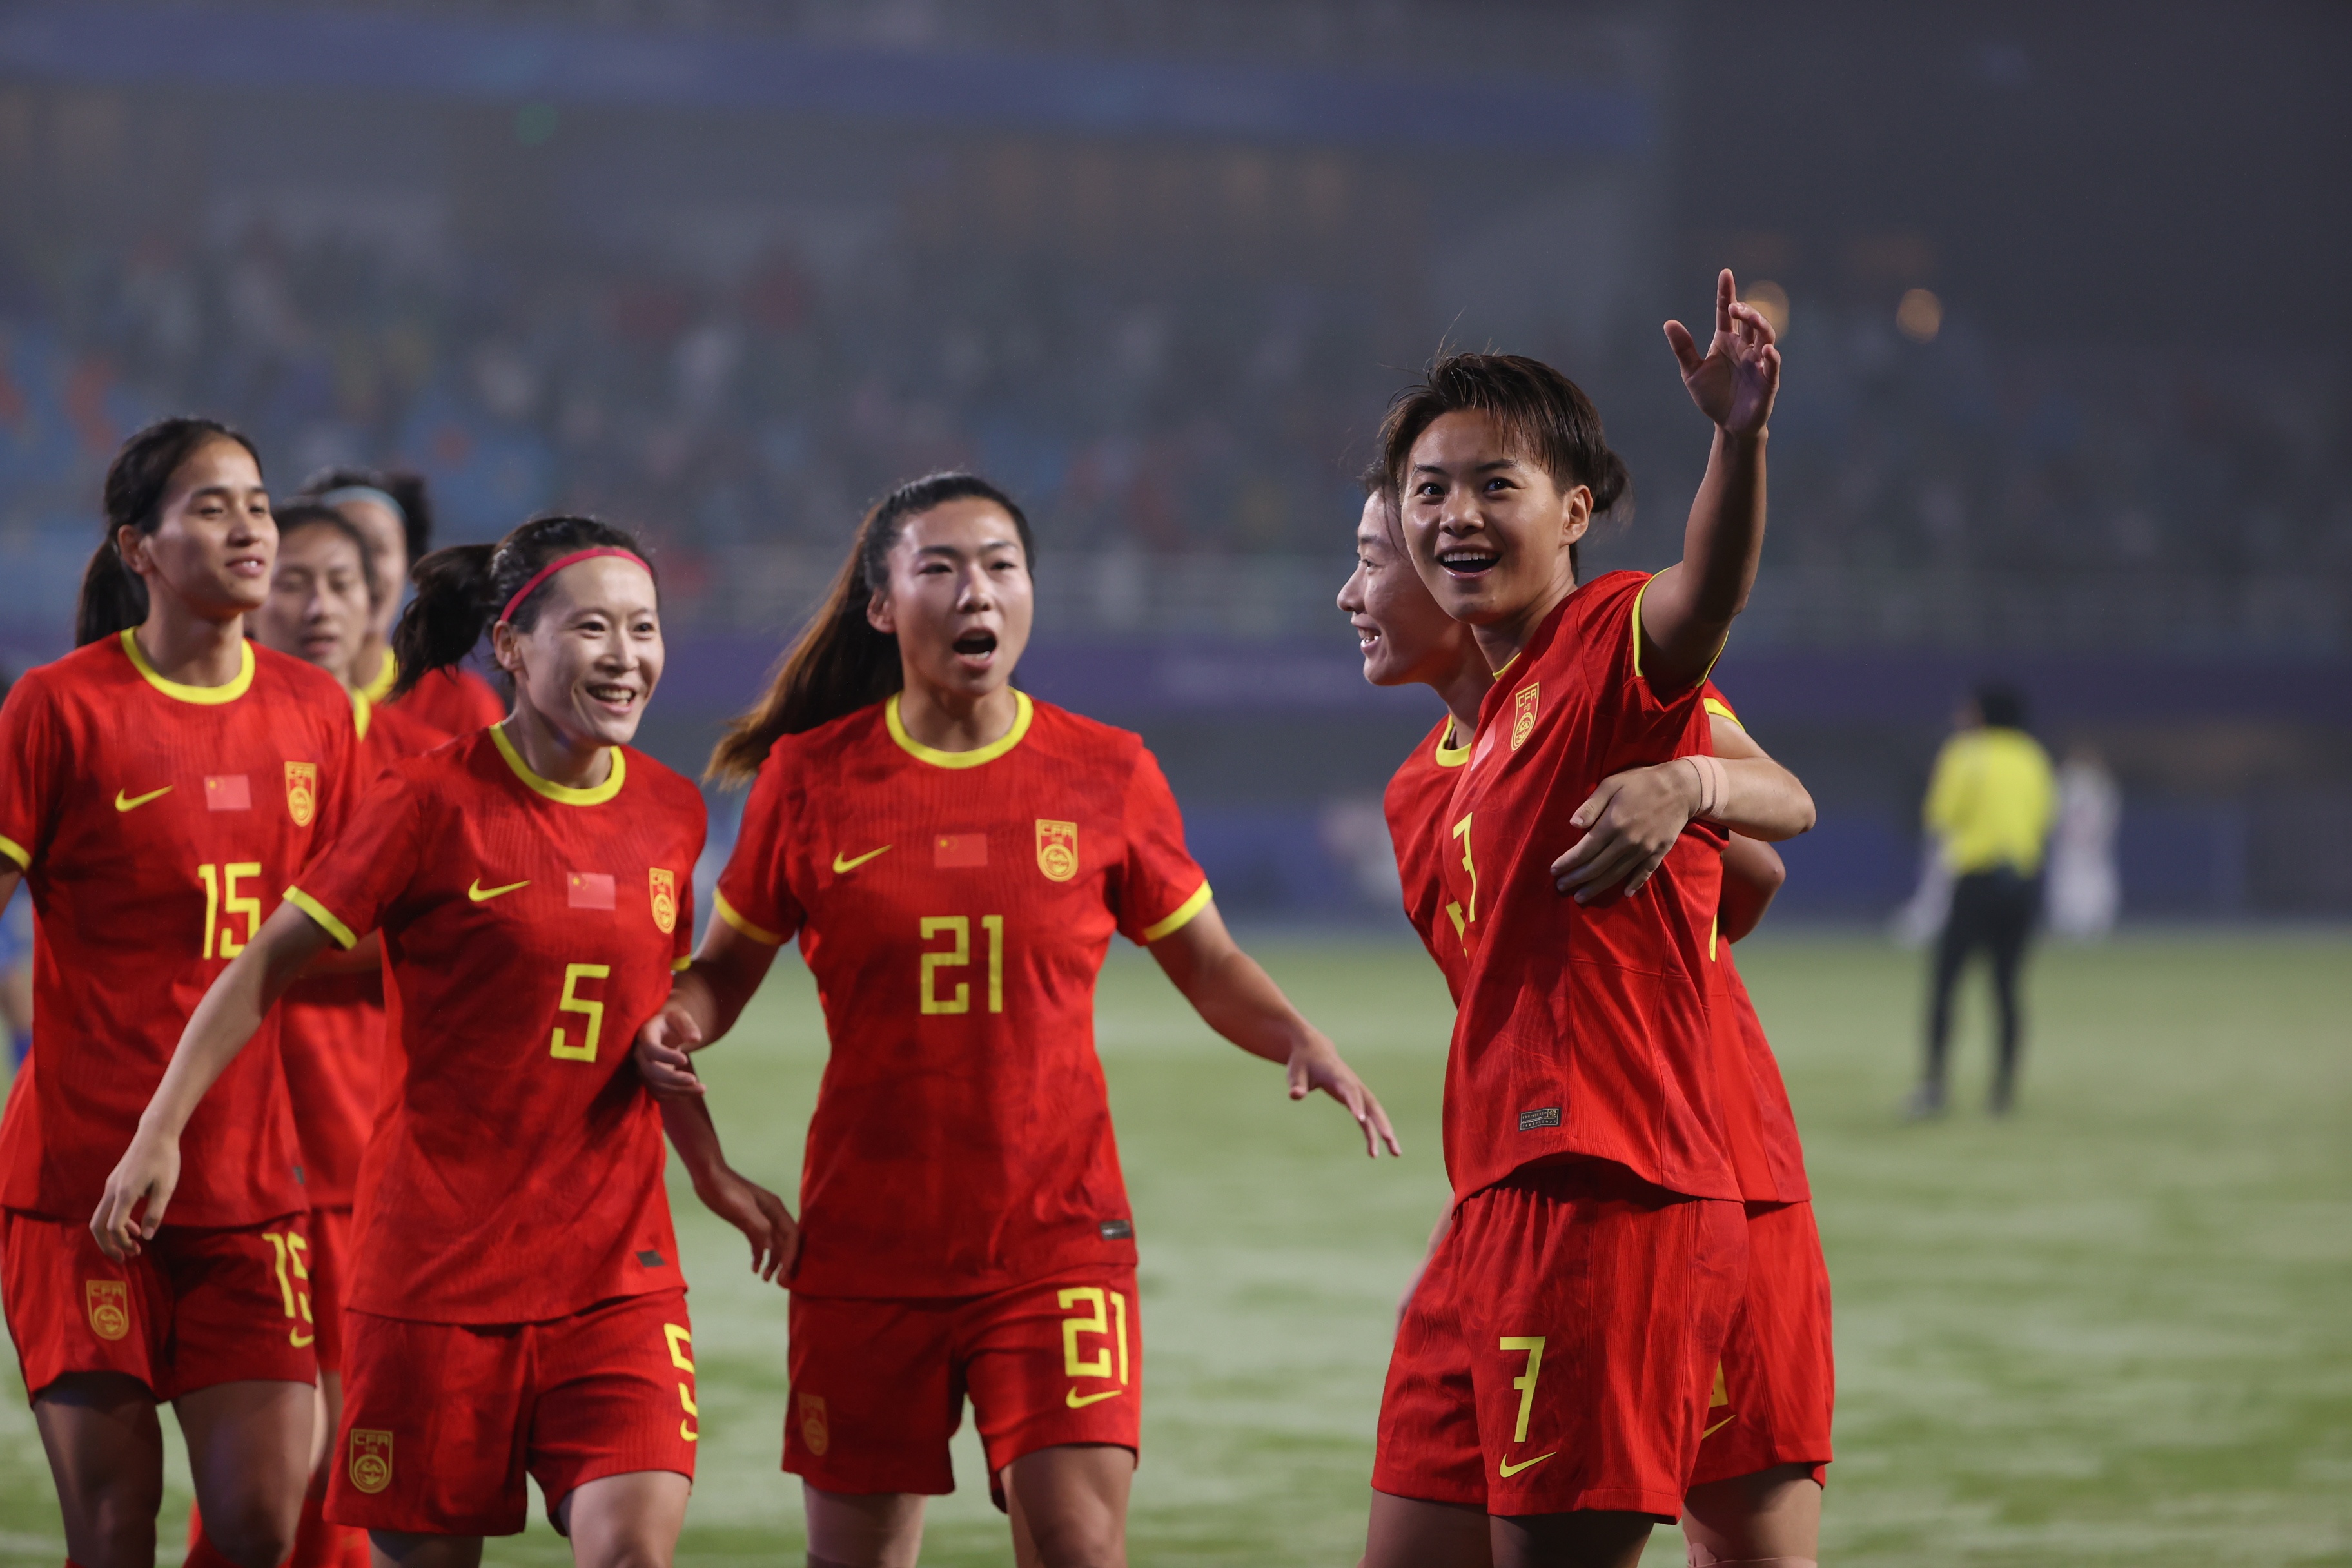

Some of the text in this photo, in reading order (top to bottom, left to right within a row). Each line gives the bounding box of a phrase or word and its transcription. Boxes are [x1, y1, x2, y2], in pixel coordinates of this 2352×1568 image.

[1518, 687, 1537, 708] CFA
[1040, 824, 1073, 837] CFA
[1453, 812, 1477, 923] 7
[198, 862, 261, 959] 15
[550, 963, 610, 1063] 5
[920, 914, 1003, 1015] 21
[1057, 1288, 1129, 1386] 21
[1500, 1336, 1546, 1443] 7
[355, 1433, 389, 1446] CFA
